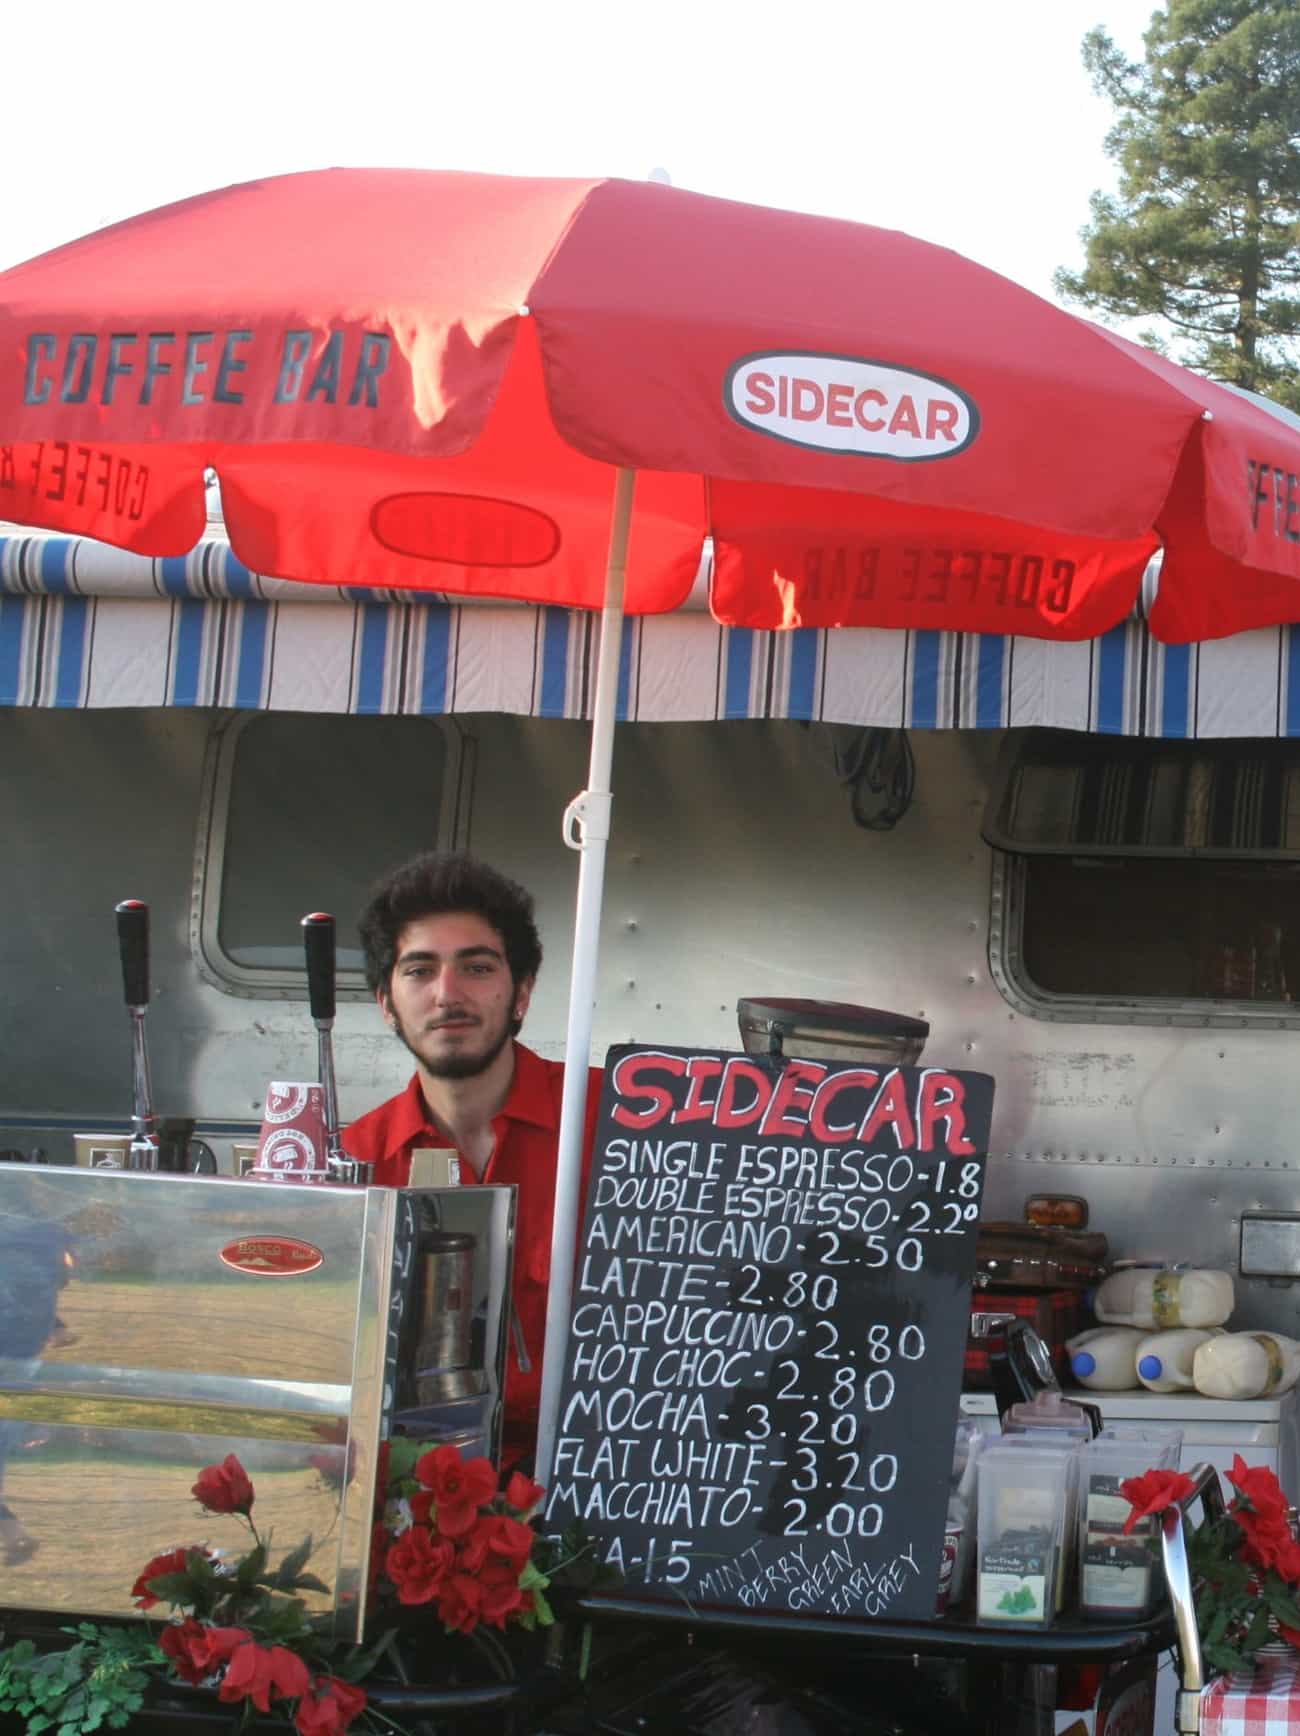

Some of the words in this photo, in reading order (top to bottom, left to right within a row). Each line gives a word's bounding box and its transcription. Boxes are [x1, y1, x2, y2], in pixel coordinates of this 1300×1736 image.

[23, 330, 255, 407] COFFEE
[273, 330, 391, 408] BAR
[744, 371, 960, 442] SIDECAR
[611, 1051, 976, 1156] SIDECAR
[603, 1139, 727, 1180] SINGLE
[594, 1176, 716, 1214] DOUBLE
[819, 1231, 923, 1271] 2.50
[814, 1321, 925, 1362] 2.80
[572, 1343, 648, 1385] HOT
[777, 1360, 895, 1411] 2.80
[745, 1403, 856, 1445] 3.20
[554, 1437, 639, 1480] FLAT
[784, 1498, 883, 1537] 2.00
[699, 1539, 762, 1599] MINT
[738, 1543, 812, 1608] BERRY
[788, 1538, 853, 1610] GREEN
[865, 1543, 920, 1616] GREY
